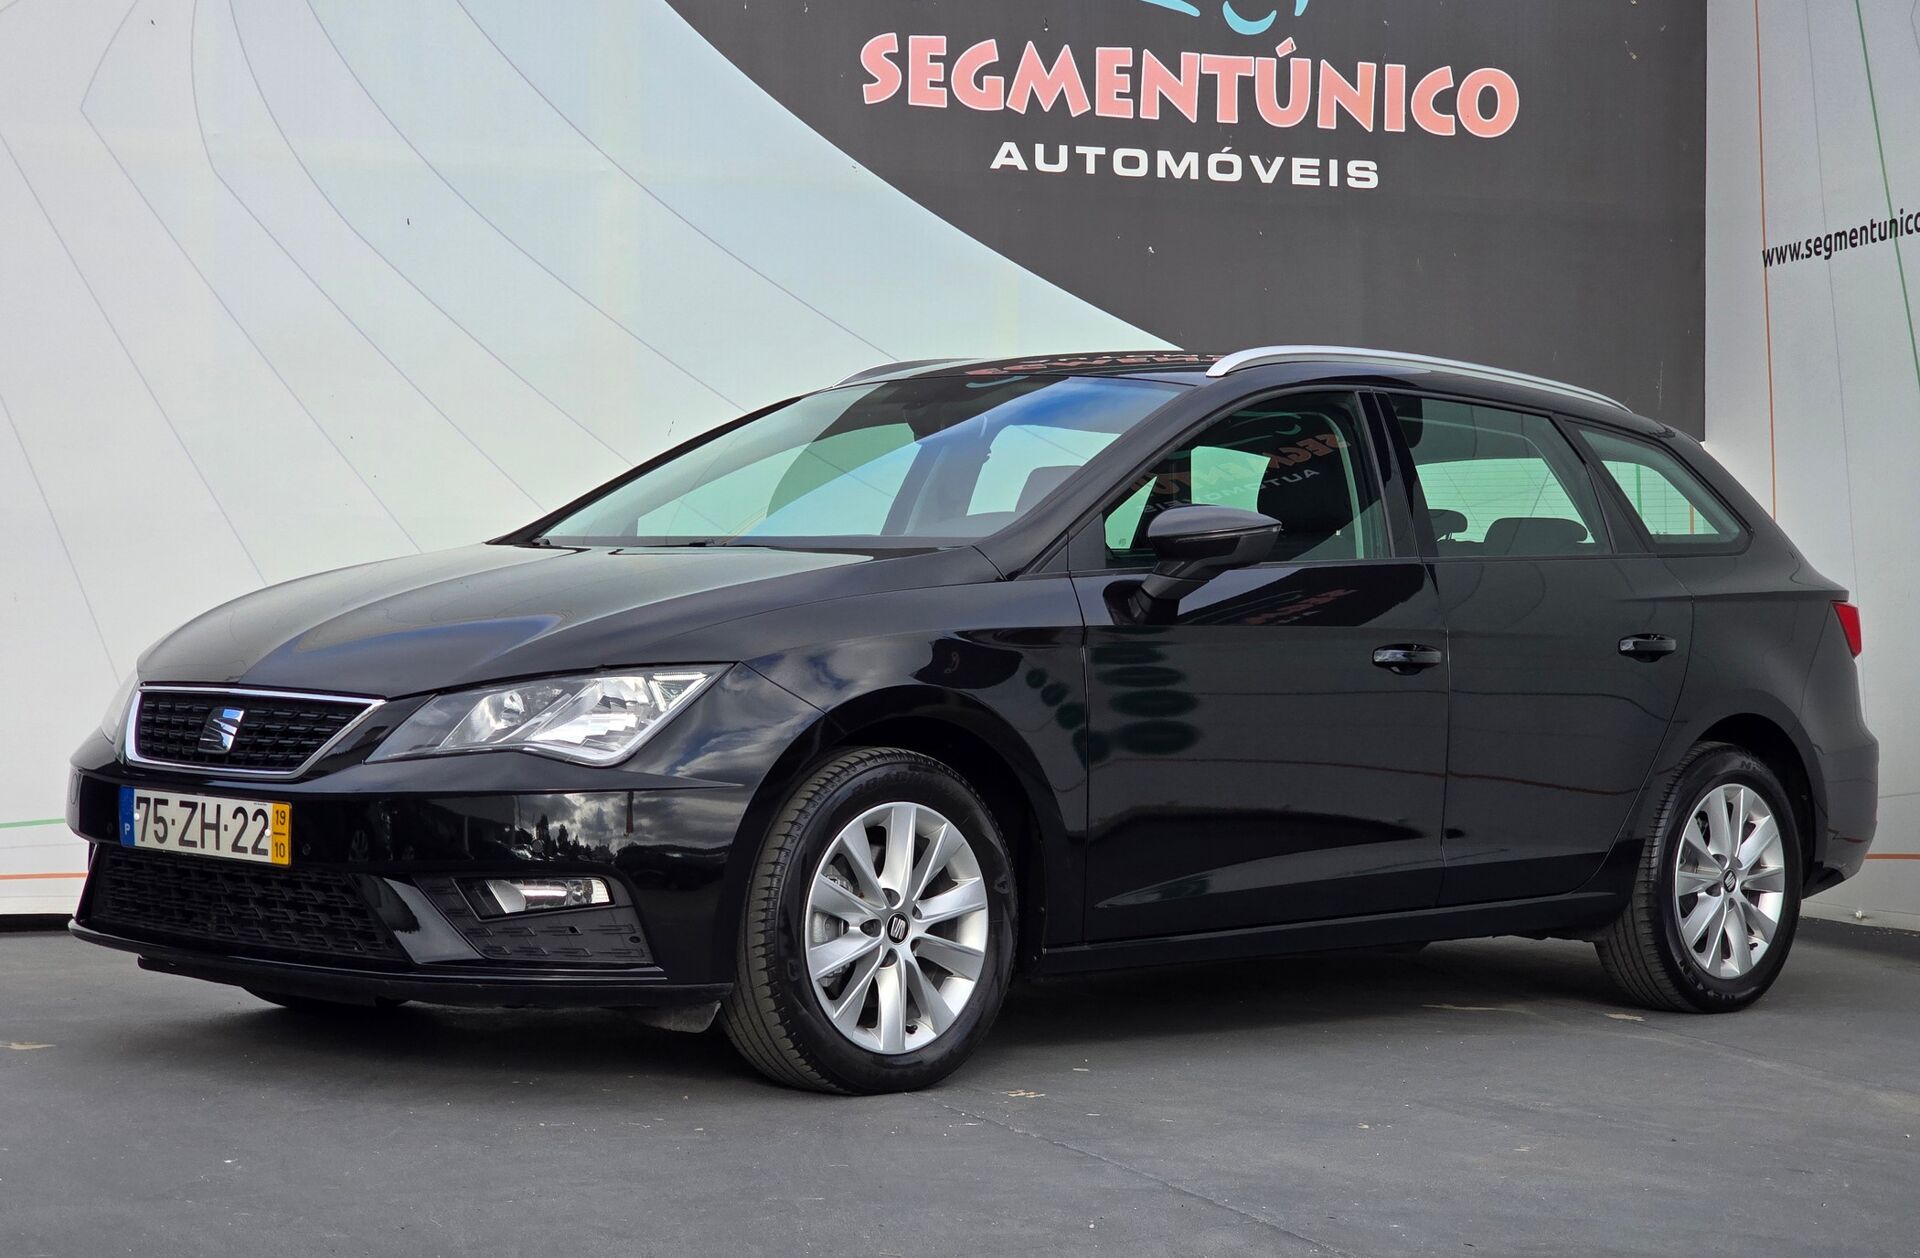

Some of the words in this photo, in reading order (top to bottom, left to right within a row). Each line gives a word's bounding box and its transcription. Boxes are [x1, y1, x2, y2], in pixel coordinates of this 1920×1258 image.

[859, 33, 1520, 138] SEGMENTÚNICO
[989, 142, 1380, 189] AUTOMÓVEIS
[275, 809, 287, 826] 19
[124, 822, 131, 836] P
[274, 841, 286, 858] 10
